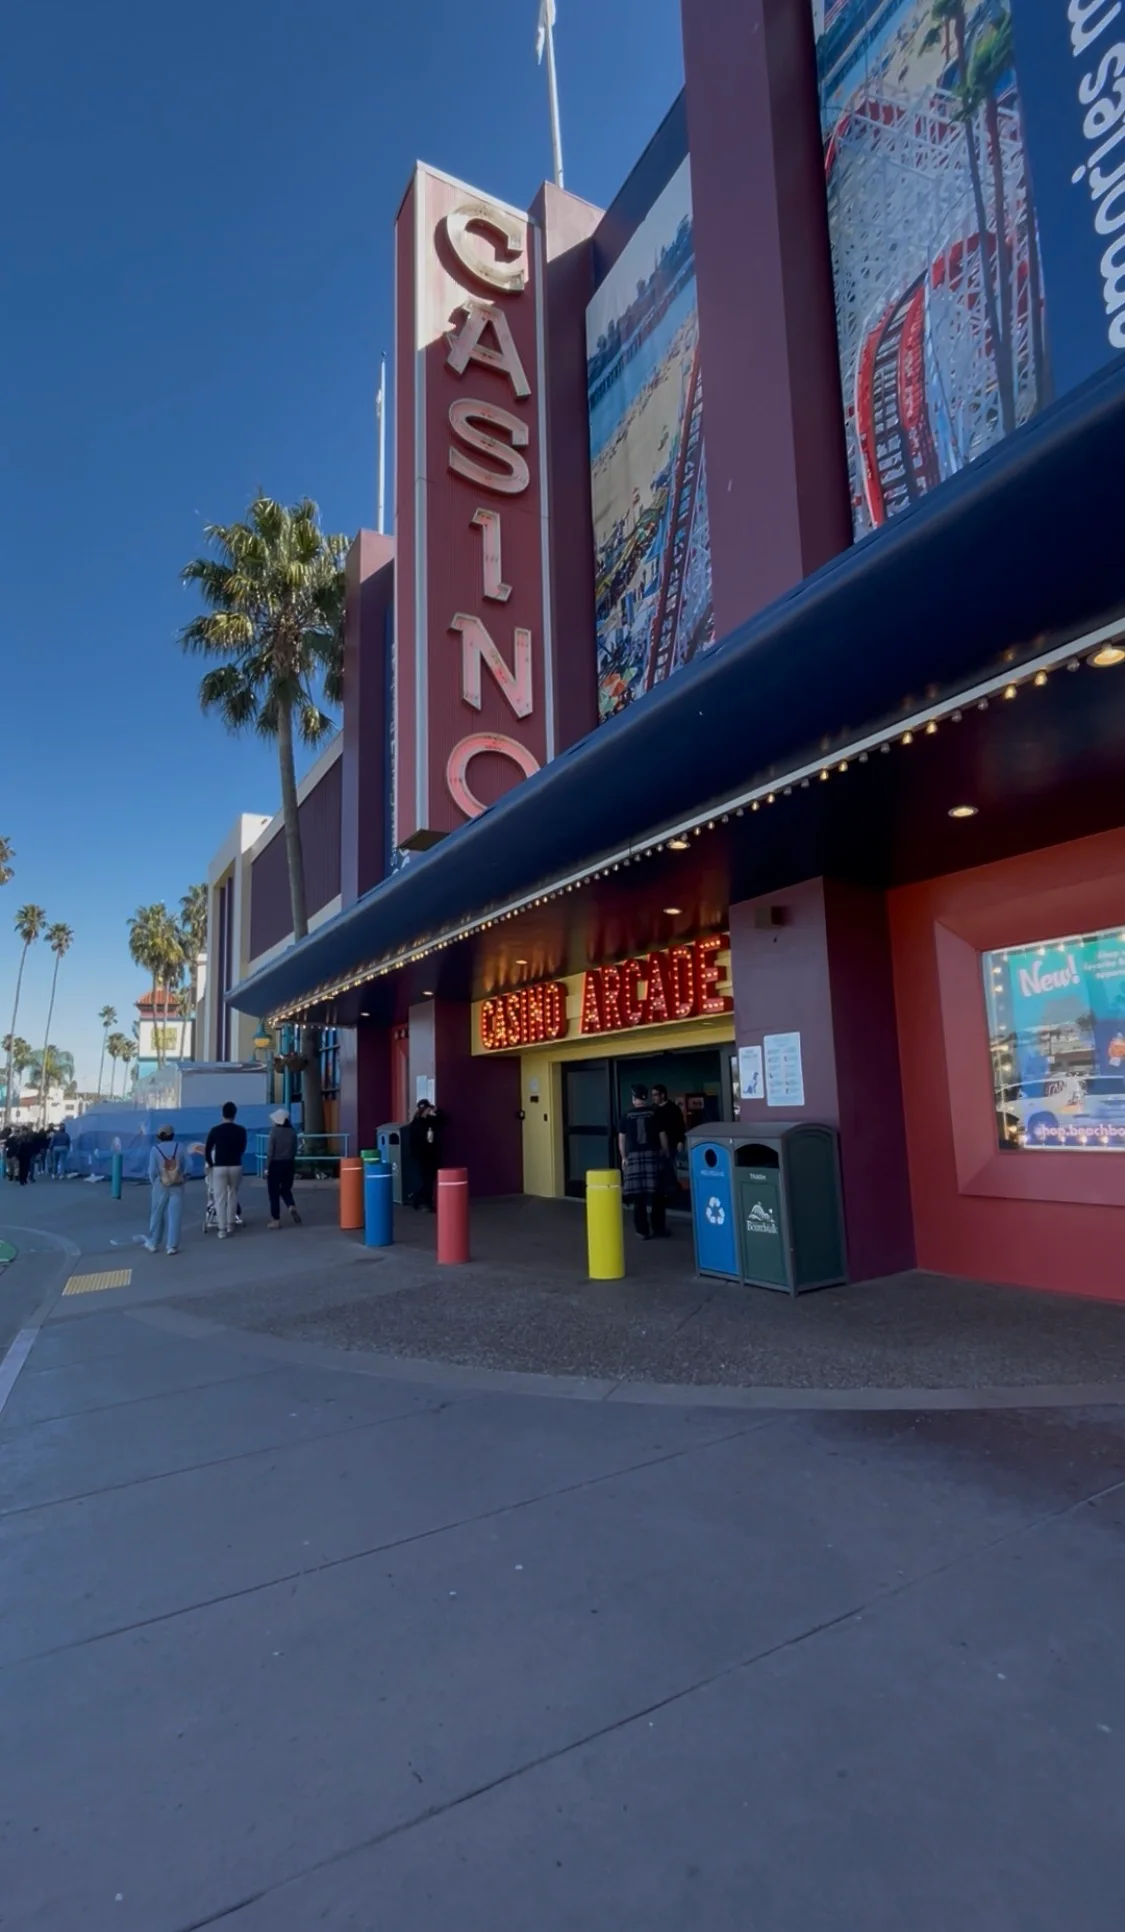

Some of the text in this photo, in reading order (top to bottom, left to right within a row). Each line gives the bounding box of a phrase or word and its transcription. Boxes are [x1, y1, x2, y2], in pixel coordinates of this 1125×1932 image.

[444, 200, 541, 818] CASINO
[481, 933, 733, 1050] CASINO ARCADE
[1019, 954, 1081, 997] New!
